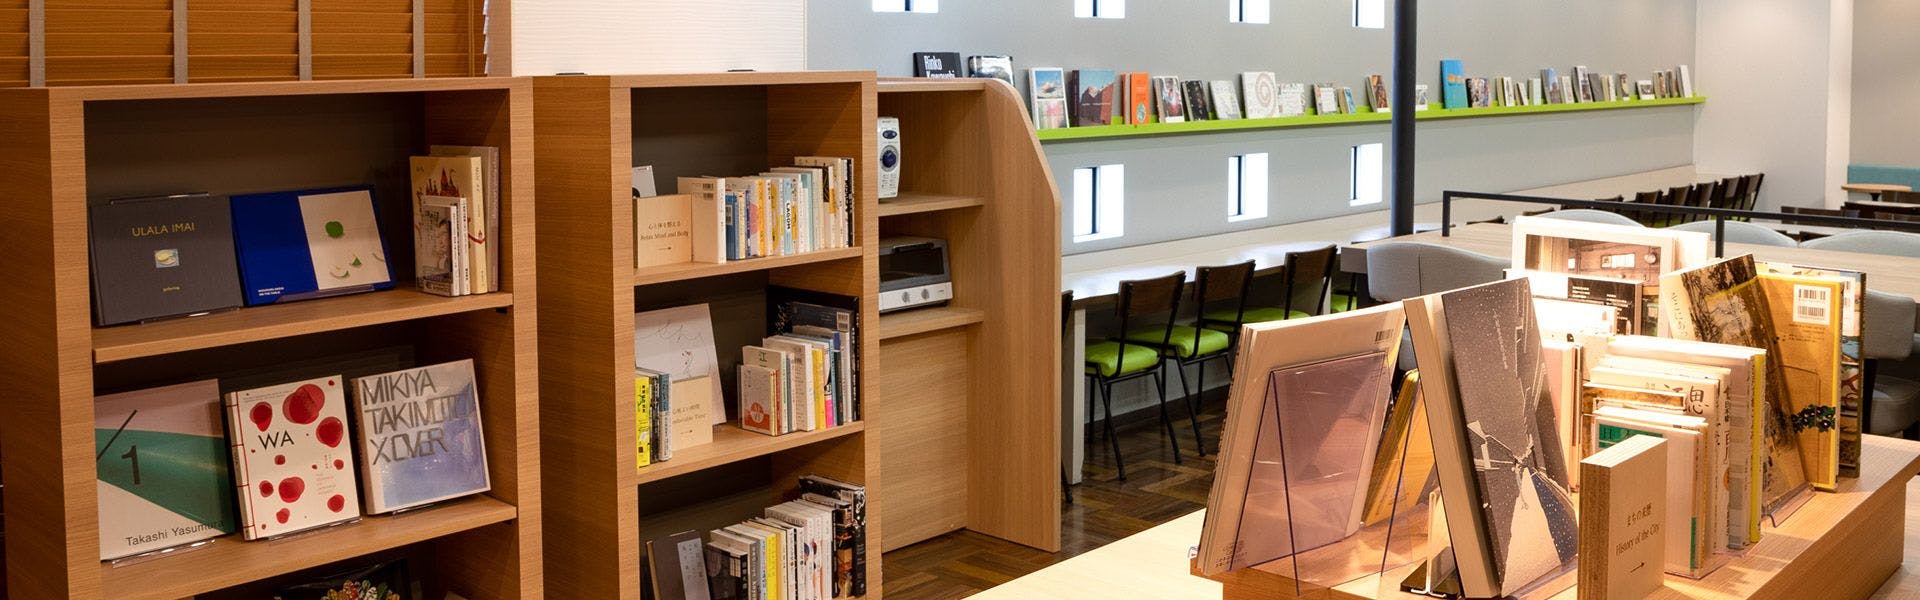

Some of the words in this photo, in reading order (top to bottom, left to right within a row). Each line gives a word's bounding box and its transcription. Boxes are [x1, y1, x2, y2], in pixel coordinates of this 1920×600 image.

[132, 224, 169, 237] ULALA
[171, 222, 195, 232] IMAI
[362, 368, 437, 405] MIKIYA
[258, 430, 295, 450] WA
[126, 529, 168, 546] Takashi
[171, 519, 225, 537] Yasumura
